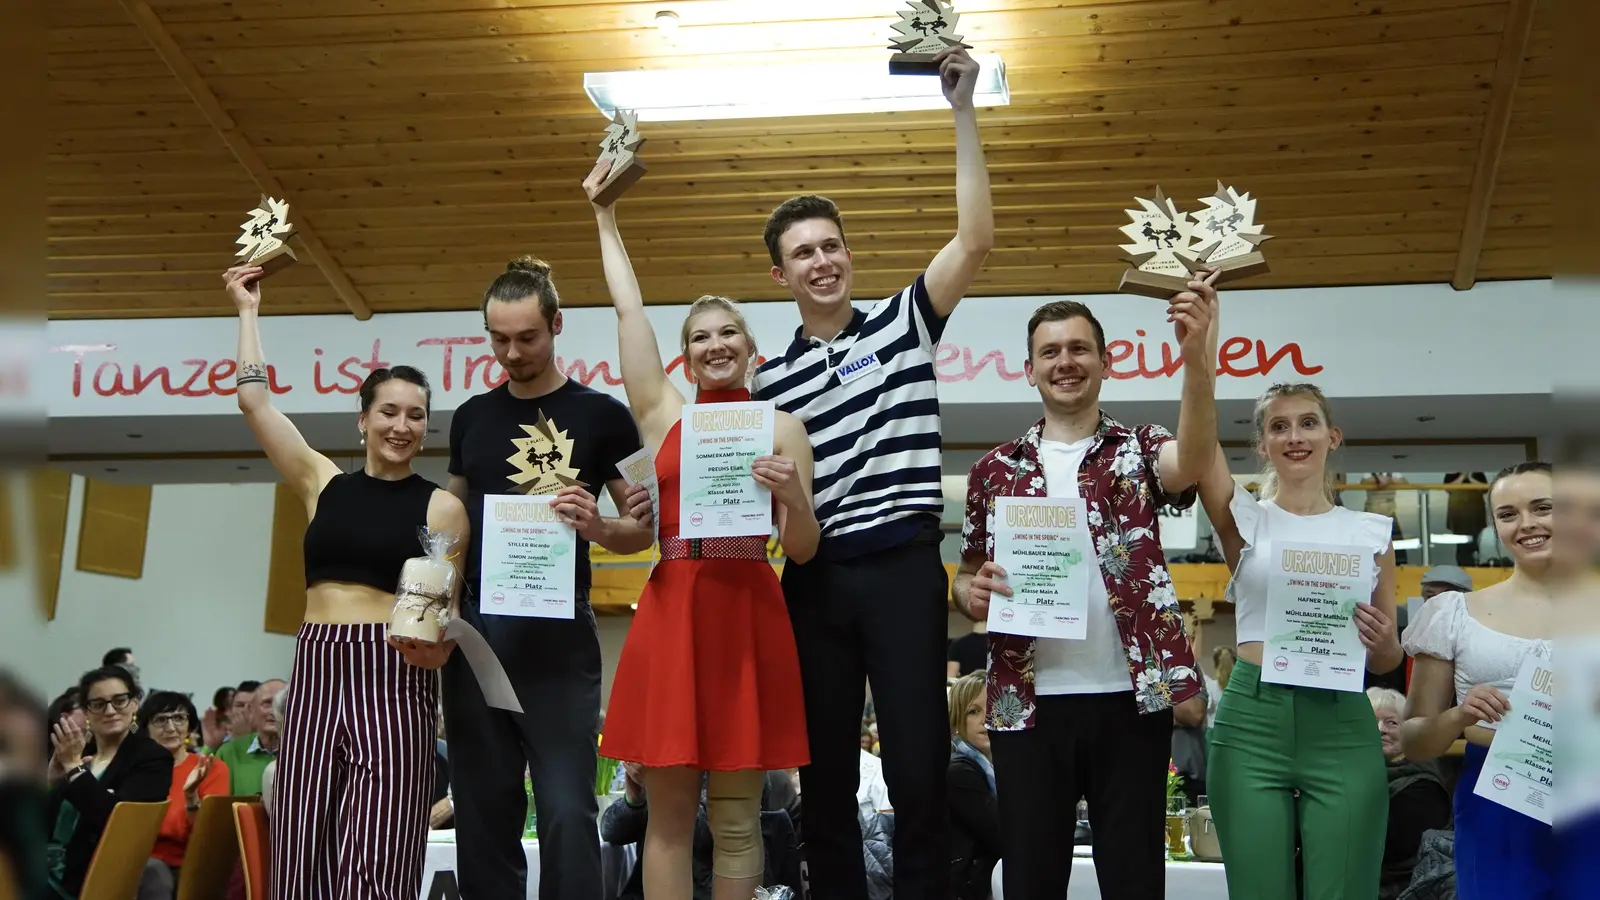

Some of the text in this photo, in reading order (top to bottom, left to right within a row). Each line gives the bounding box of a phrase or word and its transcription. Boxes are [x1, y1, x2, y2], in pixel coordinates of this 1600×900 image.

[838, 354, 876, 377] VALLOX
[693, 409, 763, 432] URKUNDE
[1006, 505, 1076, 528] URKUNDE
[1282, 549, 1361, 577] URKUNDE
[1310, 580, 1319, 588] THE
[1286, 610, 1349, 621] MÜHLBAUER Matthias
[1311, 646, 1330, 654] Platz
[1533, 734, 1553, 746] MEHL
[1524, 758, 1546, 772] Klasse
[1539, 776, 1553, 787] Pla
